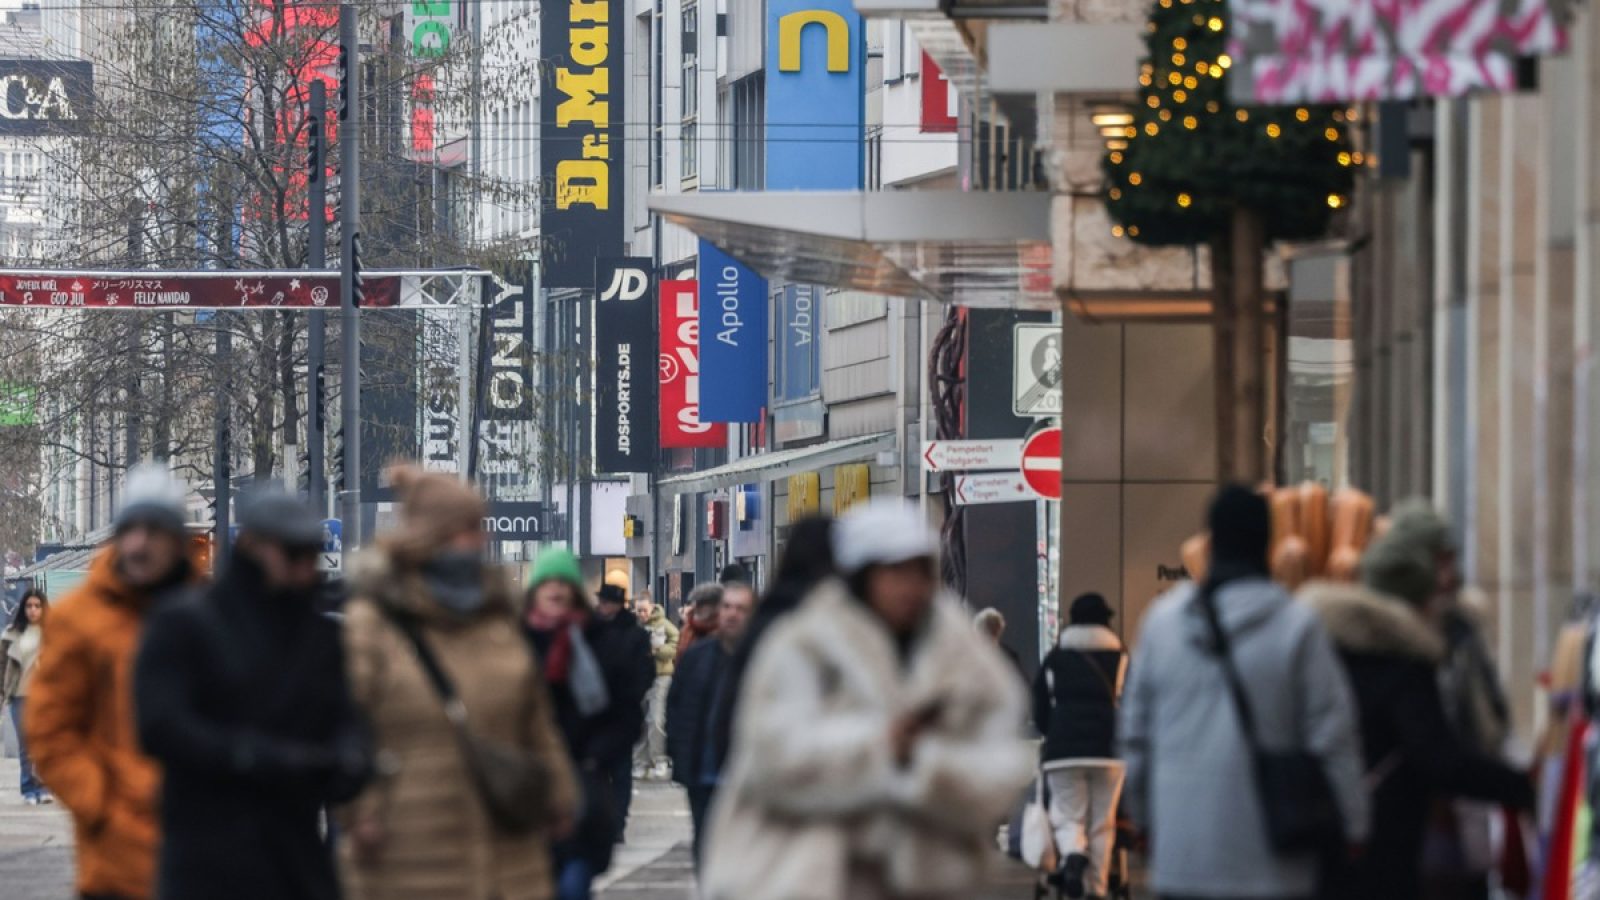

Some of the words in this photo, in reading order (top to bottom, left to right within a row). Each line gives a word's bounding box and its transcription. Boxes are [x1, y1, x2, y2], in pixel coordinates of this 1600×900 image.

[0, 75, 78, 120] C&A
[51, 291, 68, 305] GOD
[70, 291, 85, 305] JUL
[92, 280, 163, 290] メリークリスマス
[134, 291, 156, 304] FELIZ
[157, 291, 190, 304] NAVIDAD
[601, 268, 648, 301] JD
[716, 266, 744, 347] Apollo
[490, 271, 524, 409] ONLY
[617, 342, 631, 456] JDSPORTS.DE
